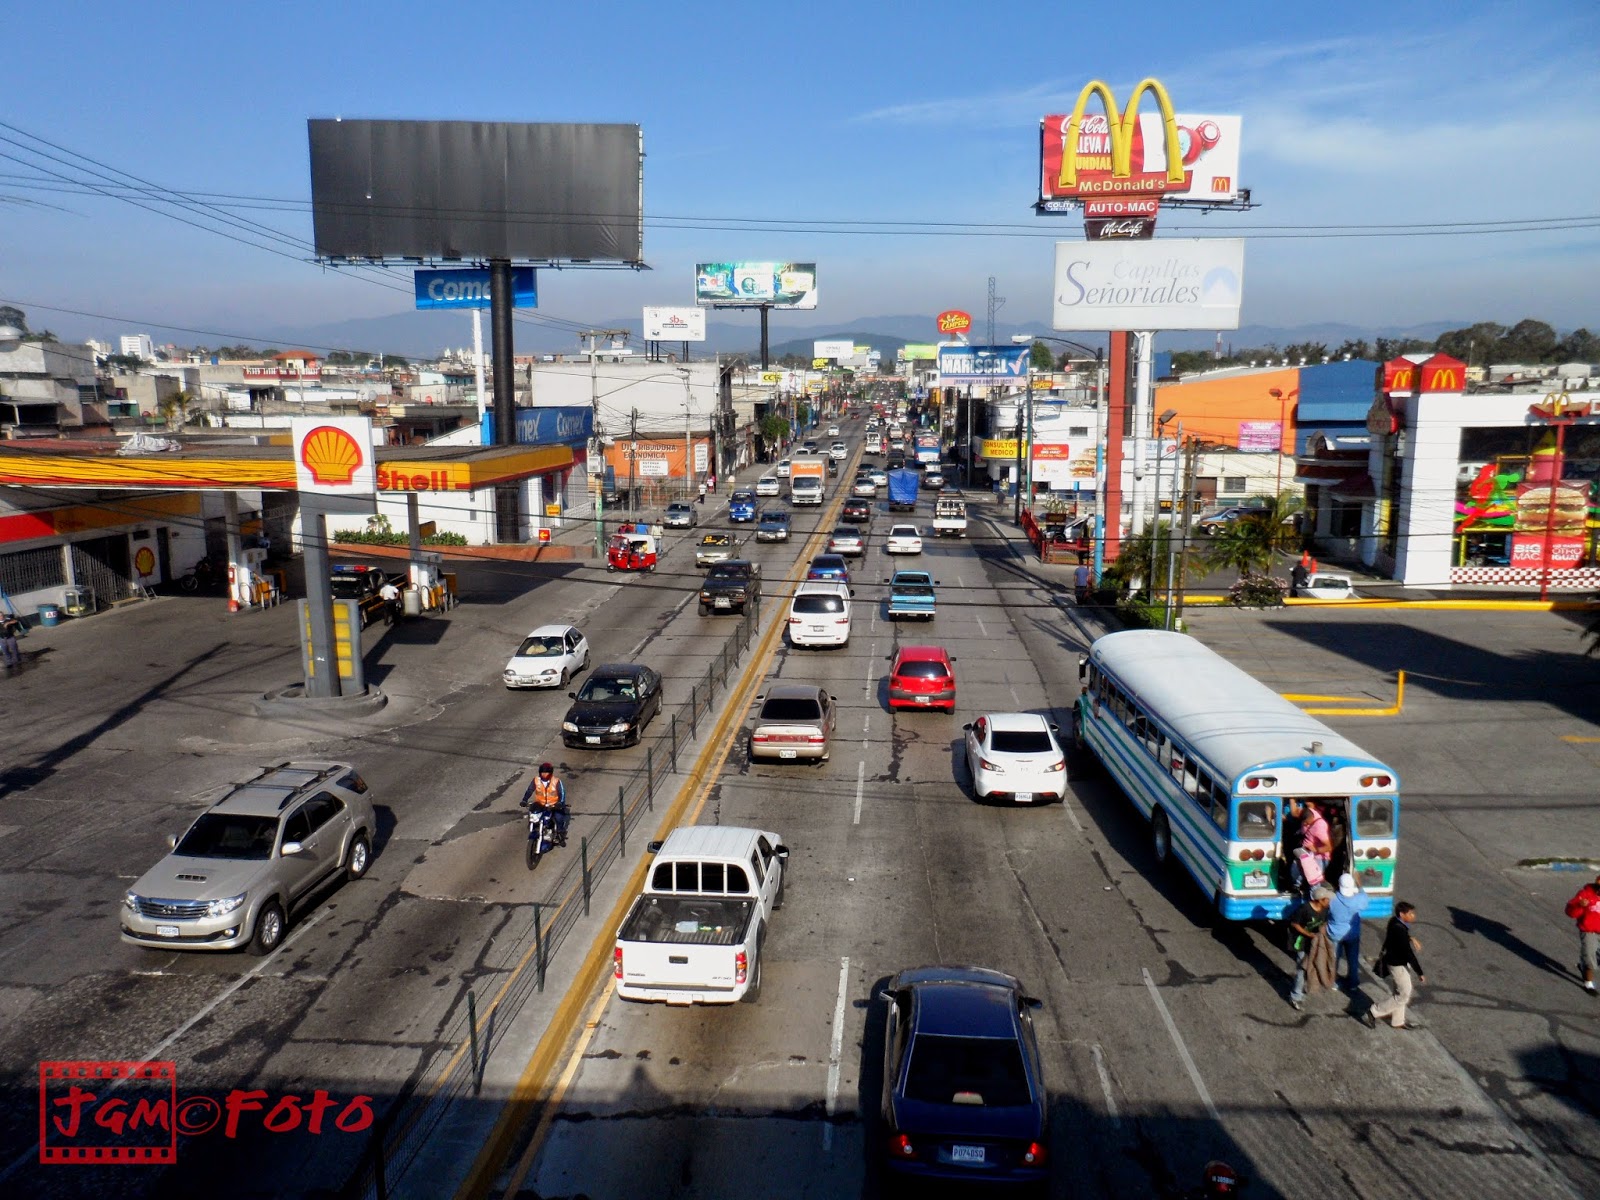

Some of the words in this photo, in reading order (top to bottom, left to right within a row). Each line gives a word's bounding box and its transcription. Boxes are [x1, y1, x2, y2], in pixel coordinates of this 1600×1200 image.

[1076, 136, 1102, 153] LEVA
[1076, 156, 1112, 170] UNDIAL
[1079, 179, 1165, 192] McDonald's
[1088, 202, 1156, 213] AUTO-MAC
[1113, 259, 1200, 283] Capillas
[1058, 260, 1200, 307] Señoriales
[941, 358, 1008, 374] MARISCAL
[556, 410, 586, 437] Comex
[983, 441, 1025, 449] CONSULTORO
[377, 468, 448, 491] Shell
[1514, 544, 1541, 553] BIG
